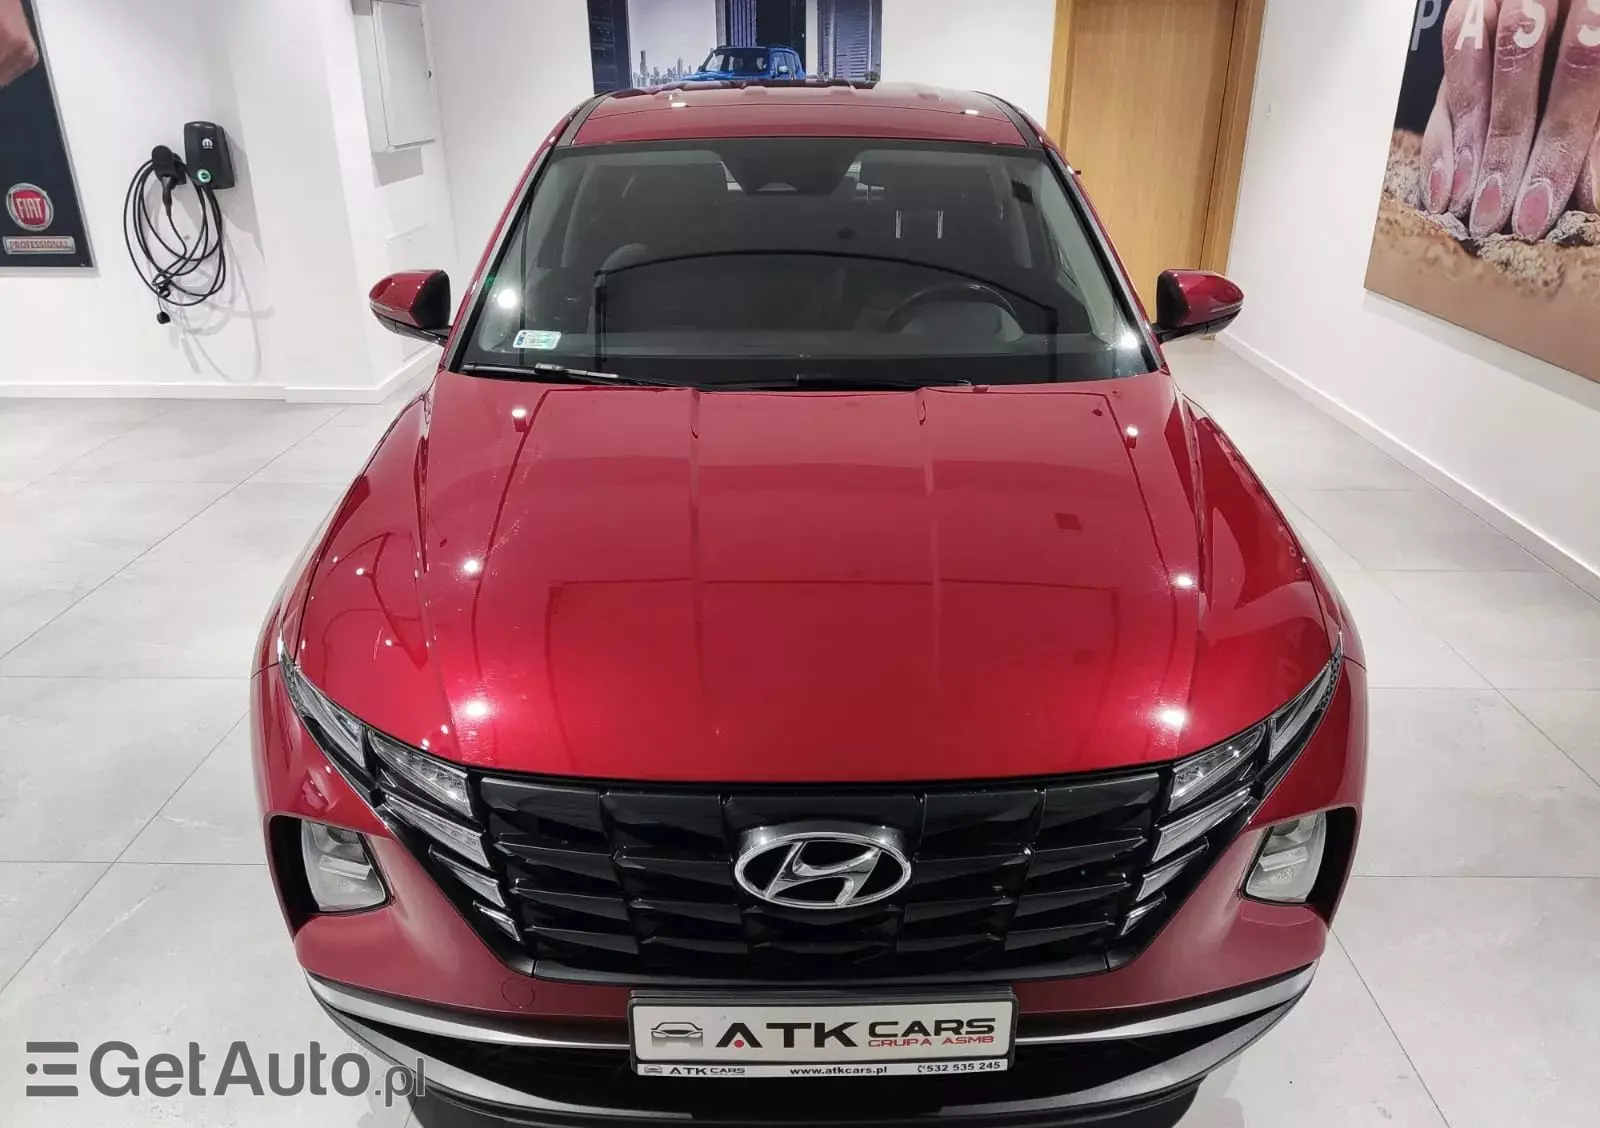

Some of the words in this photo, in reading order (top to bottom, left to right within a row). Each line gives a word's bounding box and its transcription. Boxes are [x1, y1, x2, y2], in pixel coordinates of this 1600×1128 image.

[15, 198, 44, 219] FIAT
[715, 1021, 859, 1048] ATK
[868, 1017, 996, 1038] CARS
[868, 1038, 932, 1048] GRUPA
[942, 1035, 995, 1045] ASMB
[669, 1067, 708, 1076] ATK
[789, 1066, 888, 1076] www.atkcars.pl
[926, 1064, 949, 1073] 532
[953, 1063, 975, 1072] 535
[978, 1061, 1001, 1071] 245
